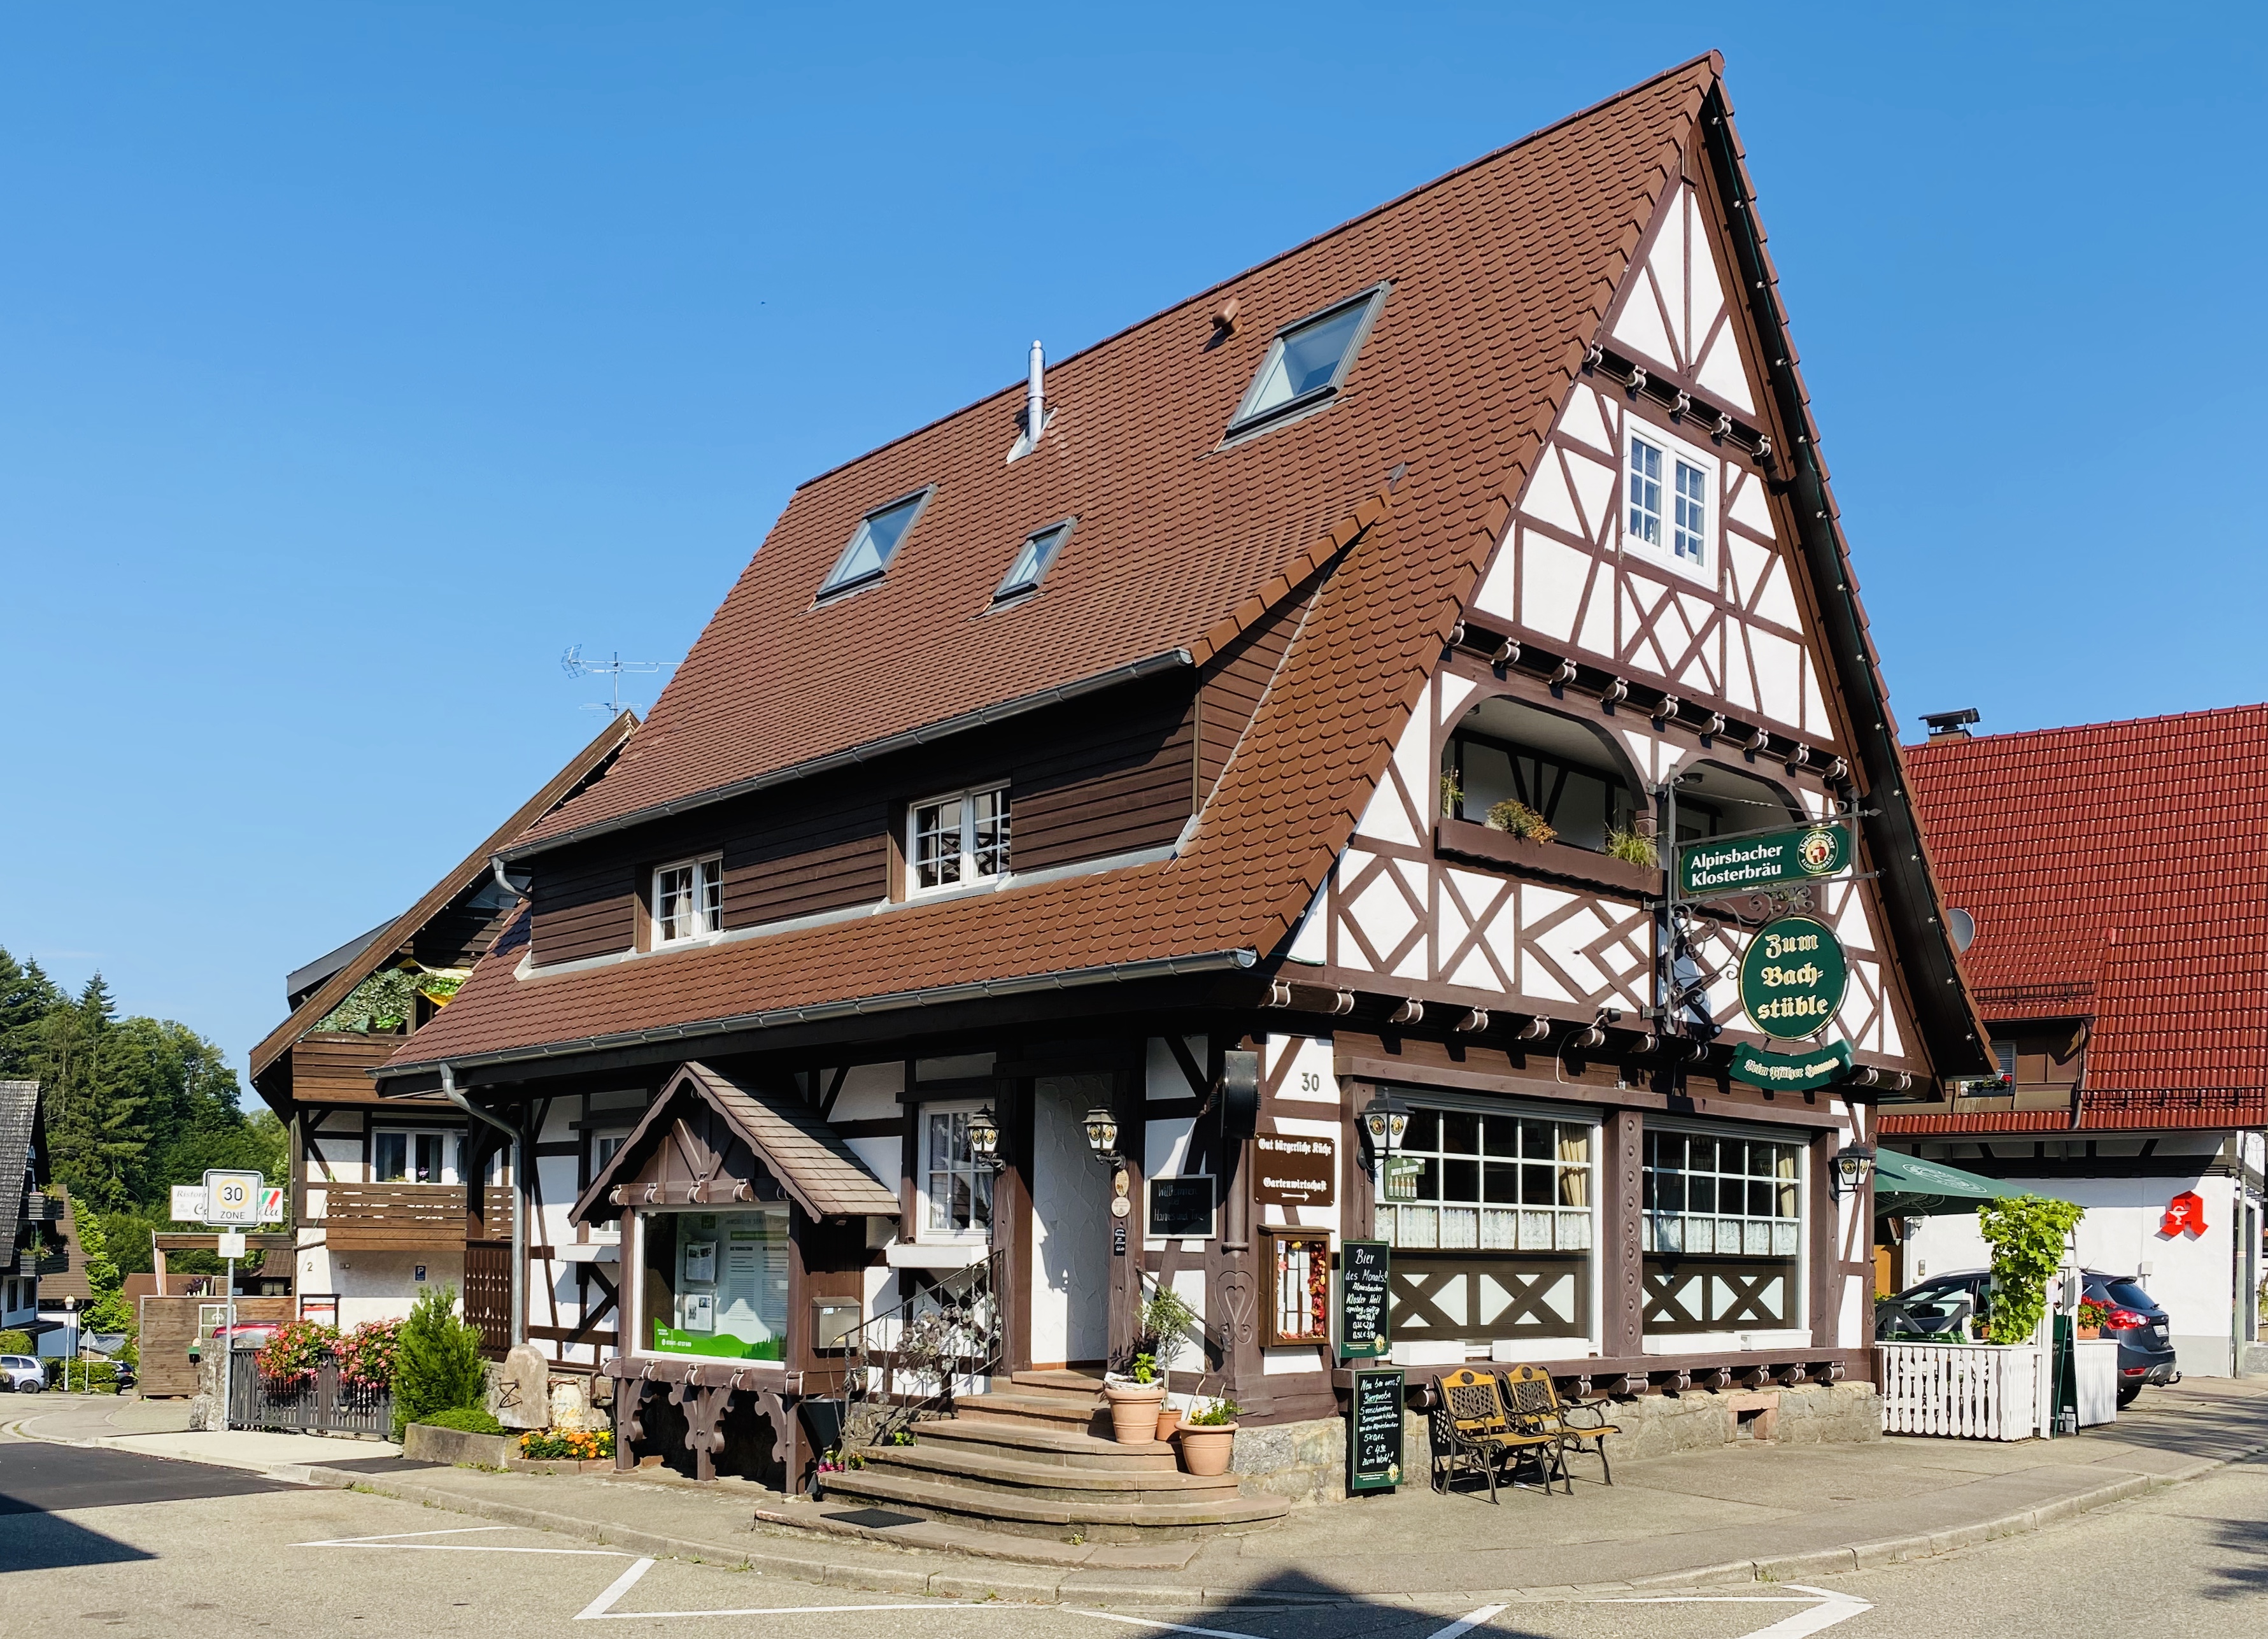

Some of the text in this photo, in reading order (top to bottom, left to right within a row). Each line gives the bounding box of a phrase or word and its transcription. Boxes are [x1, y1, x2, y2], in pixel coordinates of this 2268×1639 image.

[1799, 832, 1836, 854] Alpirsbacher
[1690, 844, 1783, 870] Alpirsbacher
[1801, 854, 1834, 870] KLOSTERBRÄU
[1692, 862, 1782, 887] Klosterbräu
[1765, 933, 1819, 959] Zum
[1757, 995, 1828, 1019] stüble
[1744, 1059, 1769, 1076] Beim
[1769, 1066, 1803, 1080] Pfälzer
[1301, 1072, 1319, 1091] 30
[1258, 1138, 1331, 1156] Gut bürgerliche Küche
[1263, 1177, 1327, 1192] Gartenwirtschaft
[224, 1187, 243, 1201] 30
[220, 1211, 246, 1219] ZONE
[1355, 1249, 1375, 1265] Bier
[307, 1262, 313, 1272] 2
[1345, 1270, 1358, 1281] des
[1346, 1293, 1381, 1304] Kloster Hell
[1360, 1379, 1372, 1391] Neu
[1359, 1406, 1365, 1416] 5
